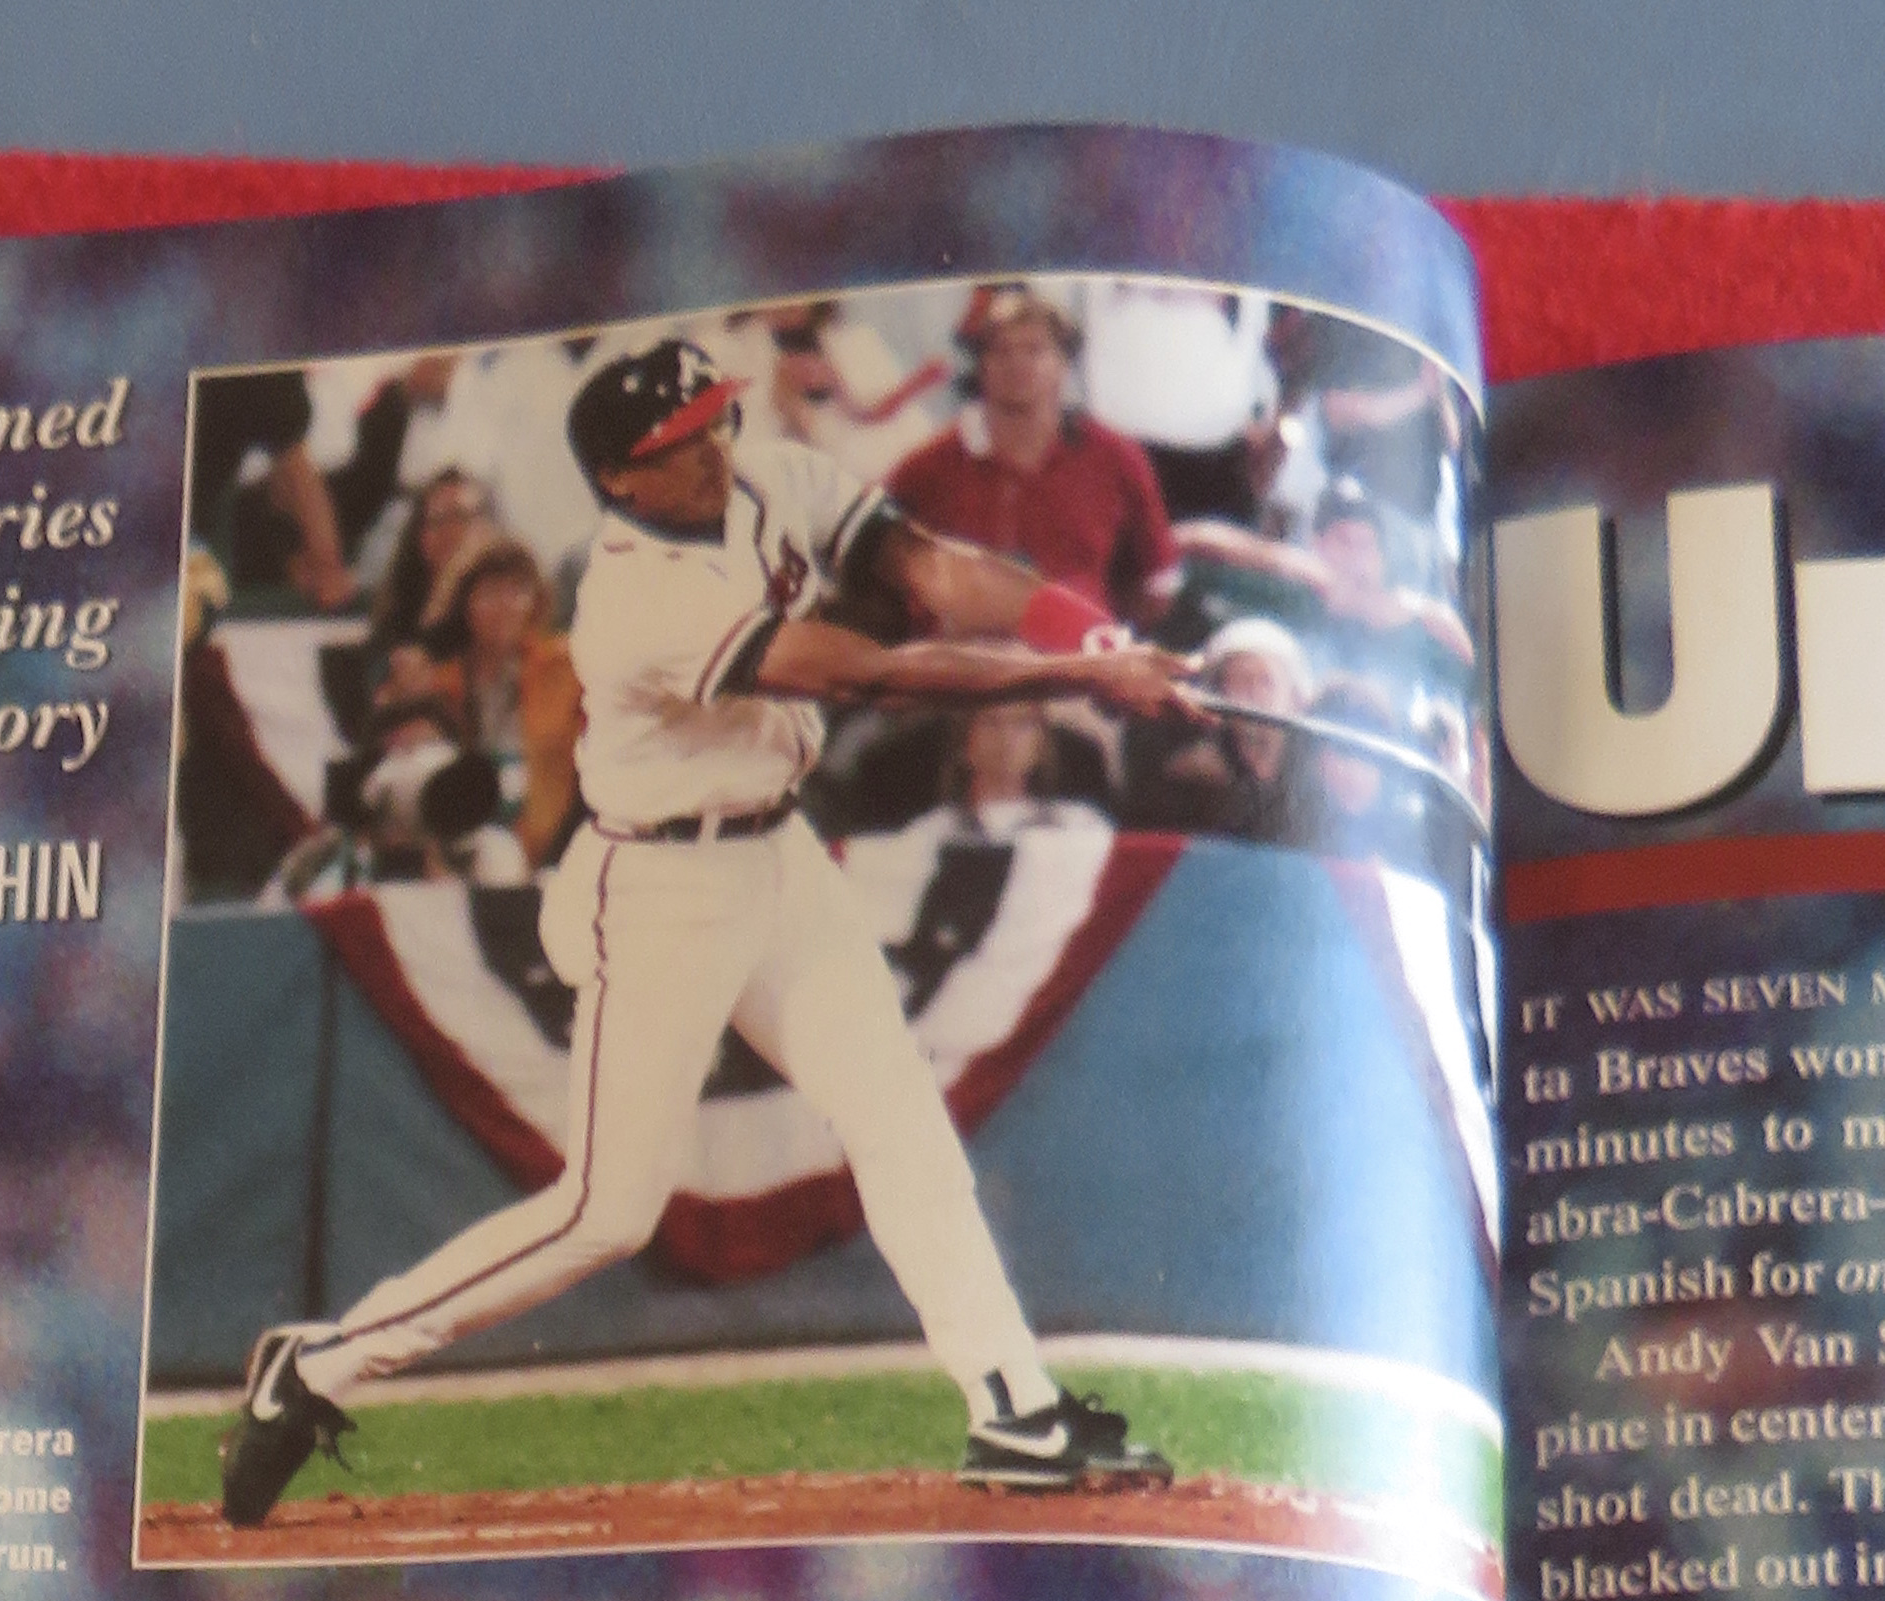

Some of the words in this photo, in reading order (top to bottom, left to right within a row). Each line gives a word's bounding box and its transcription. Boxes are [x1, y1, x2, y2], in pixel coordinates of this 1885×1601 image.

[1521, 994, 1563, 1034] IT
[1587, 981, 1683, 1025] WAS
[1703, 971, 1848, 1014] SEVEN
[1524, 1061, 1572, 1102] ta
[1595, 1044, 1771, 1095] Braves
[1525, 1117, 1737, 1173] minutes
[1763, 1113, 1814, 1153] to
[1529, 1255, 1737, 1323] Spanish
[1750, 1250, 1824, 1297] for
[1595, 1326, 1734, 1383] Andy
[1756, 1323, 1856, 1374] Van
[1535, 1405, 1650, 1471] pine
[1664, 1403, 1714, 1449] in
[1537, 1479, 1650, 1531] shot
[1669, 1470, 1811, 1521] dead.
[1755, 1542, 1842, 1589] out
